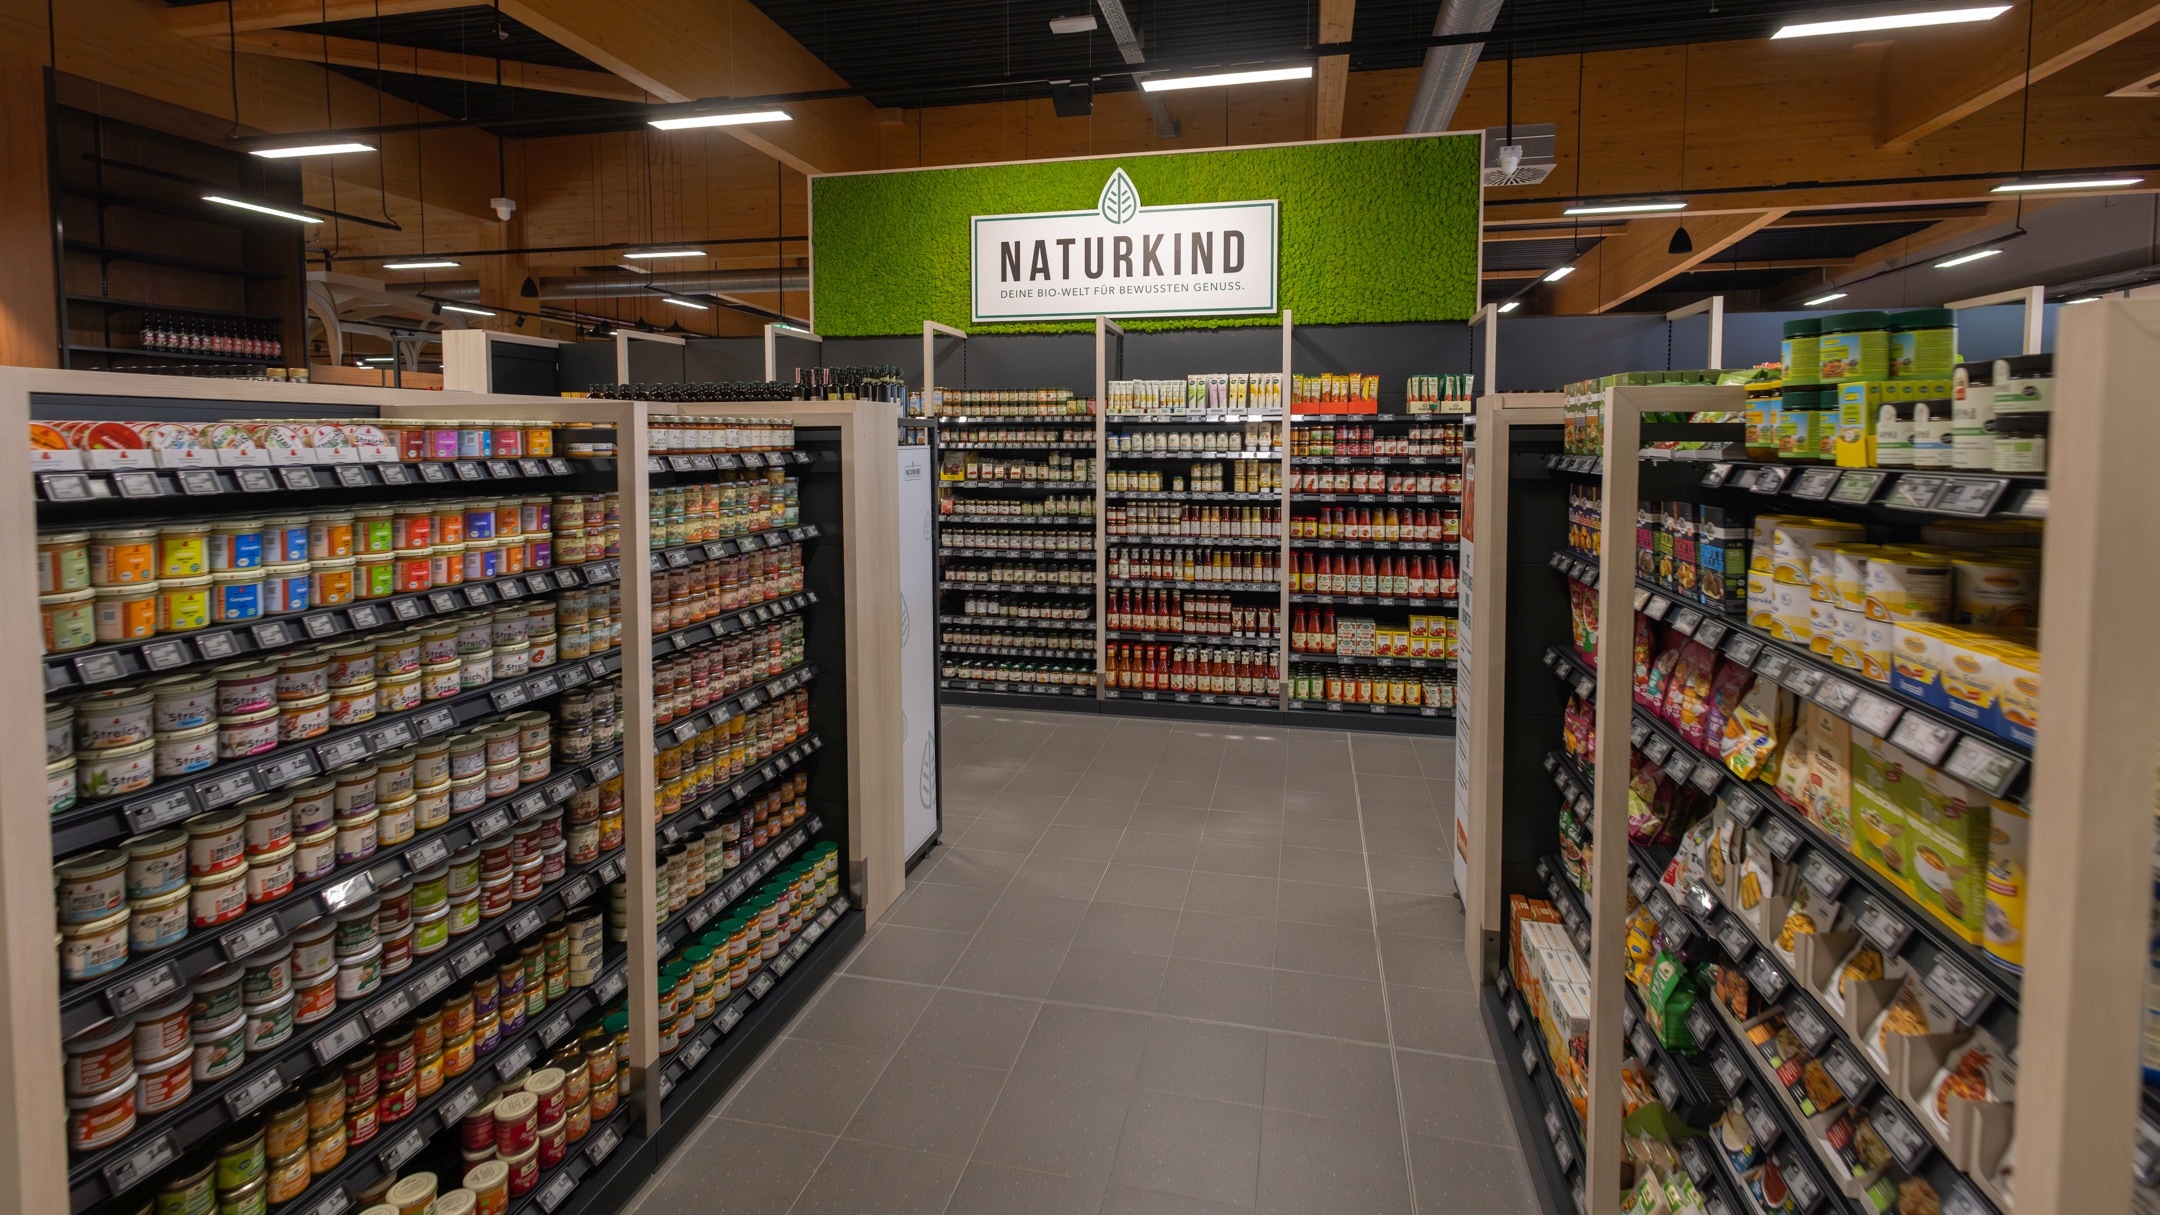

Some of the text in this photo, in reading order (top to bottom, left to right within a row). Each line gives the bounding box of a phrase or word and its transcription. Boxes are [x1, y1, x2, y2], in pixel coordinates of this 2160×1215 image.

[1000, 230, 1245, 282] NATURKIND
[1000, 281, 1246, 299] DEINE BIO-WELT FÜR BEWUSSTEN GENUSS.
[495, 630, 523, 639] Streich
[458, 639, 487, 649] Streich
[276, 681, 309, 693] treich
[433, 681, 458, 693] Streic
[111, 768, 153, 787] Streic
